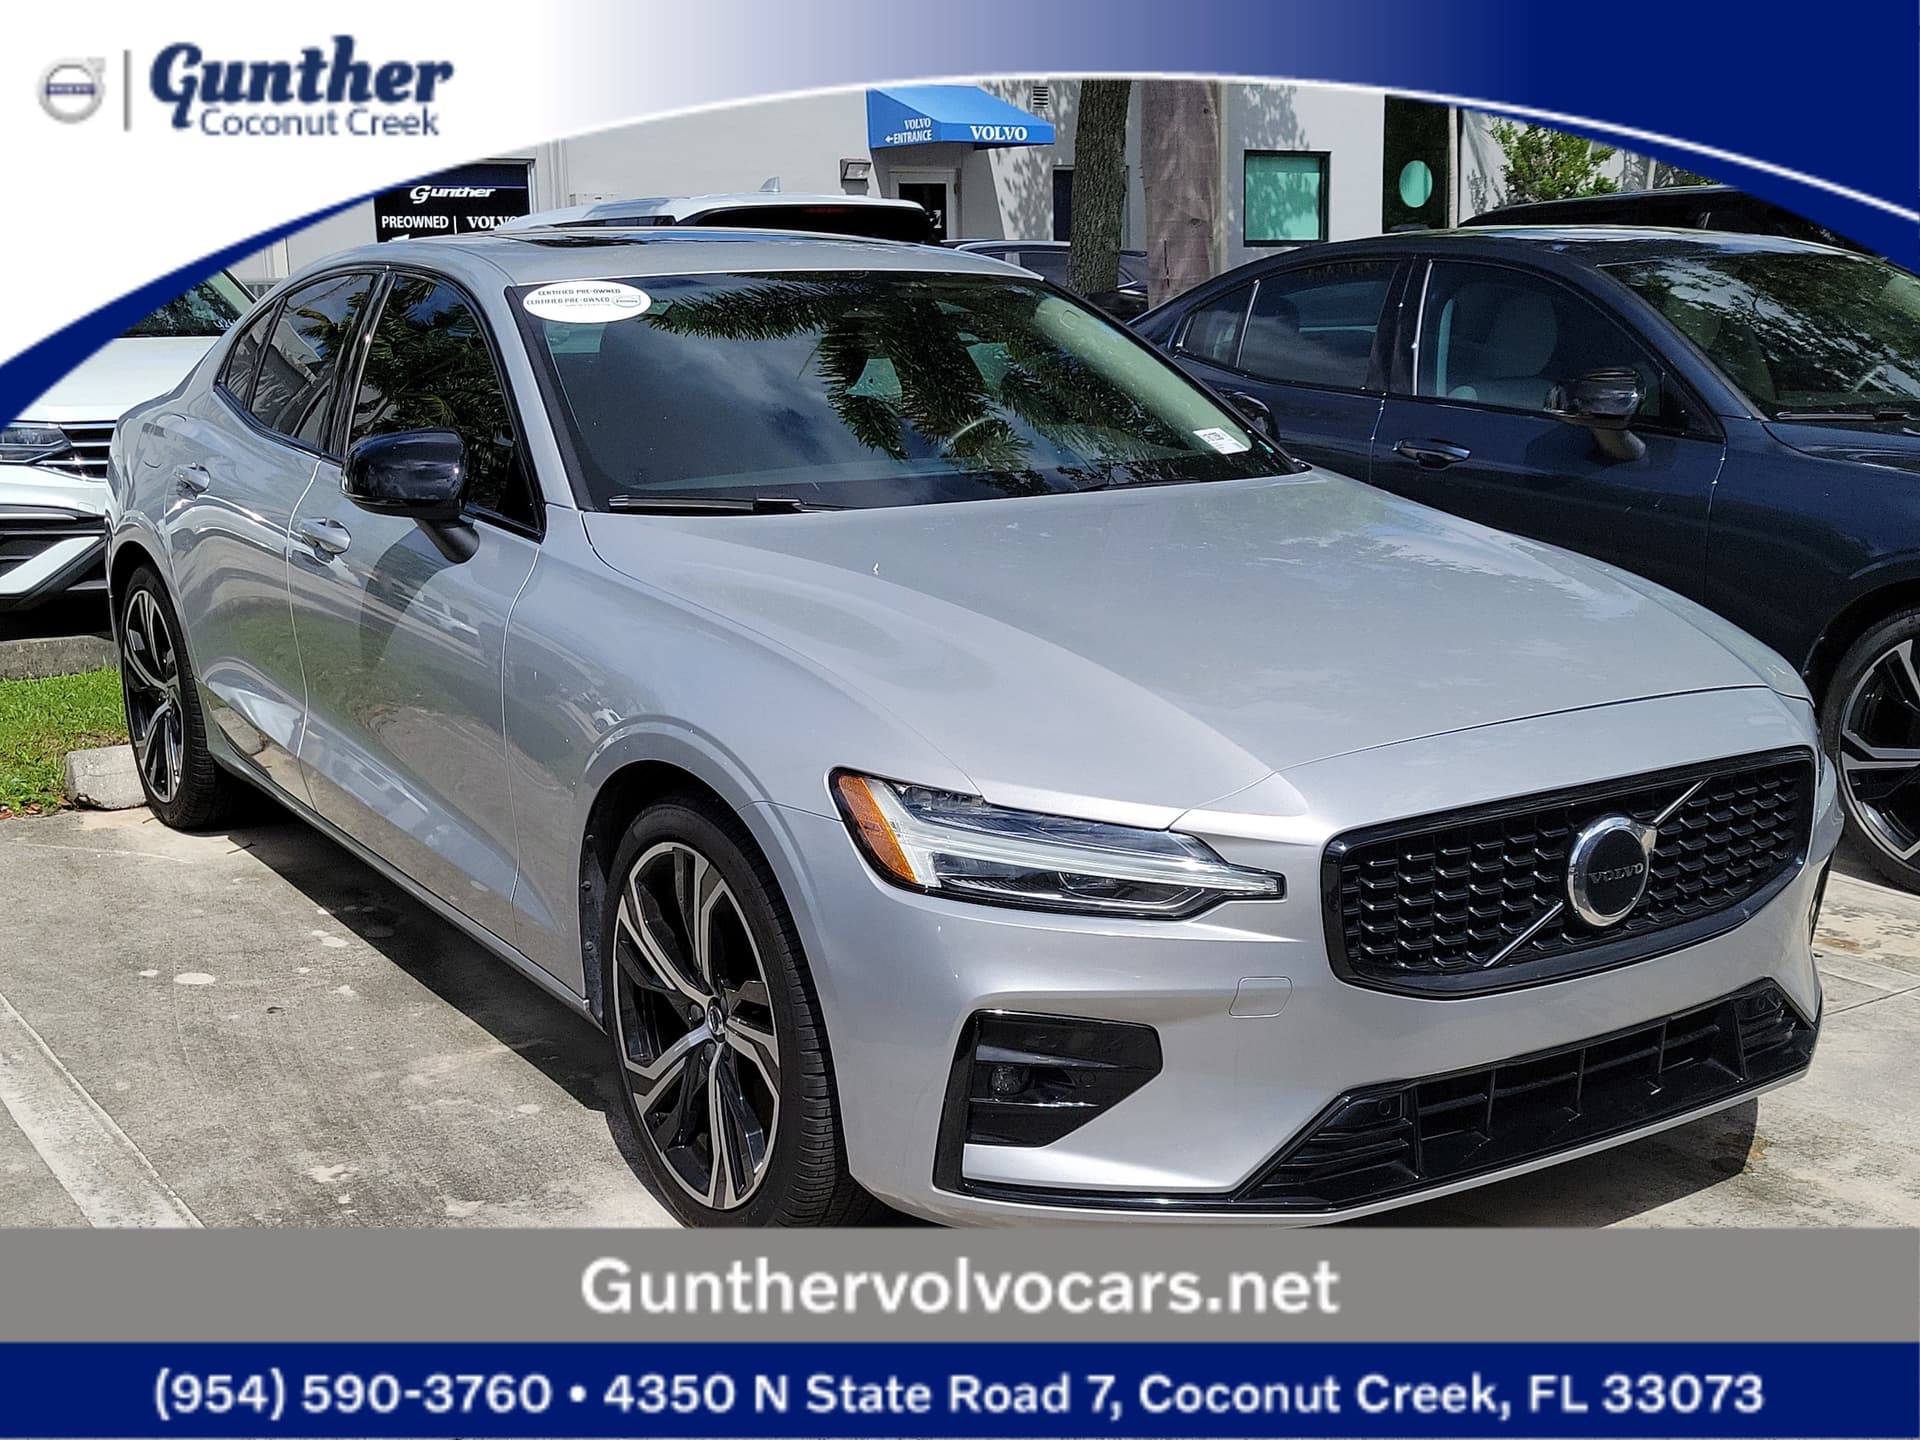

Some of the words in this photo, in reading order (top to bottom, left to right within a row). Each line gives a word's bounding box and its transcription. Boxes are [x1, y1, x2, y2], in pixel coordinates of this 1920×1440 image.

[904, 118, 931, 130] VOLVO
[893, 130, 932, 144] ENTRANCE
[970, 125, 1028, 141] VOLVO
[409, 185, 496, 204] Gunther
[381, 215, 449, 229] PREOWNED
[1588, 862, 1644, 884] VOLVO
